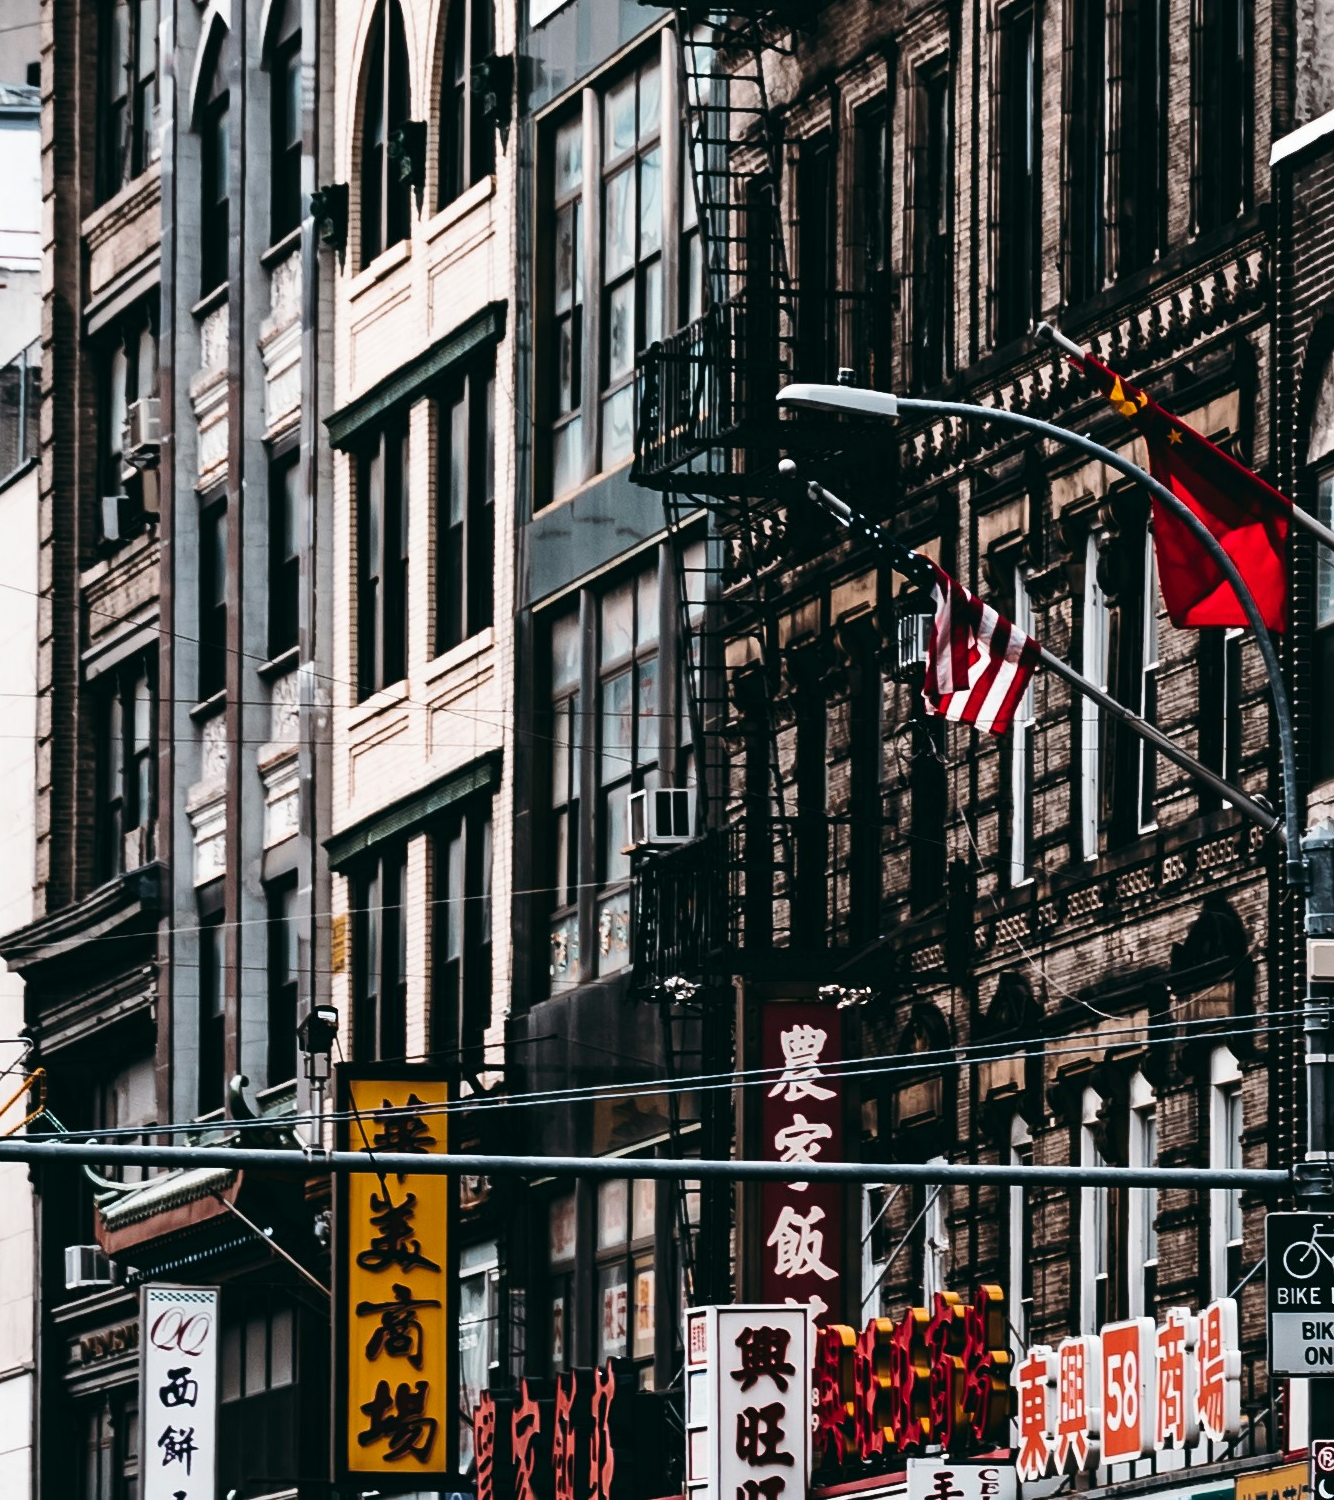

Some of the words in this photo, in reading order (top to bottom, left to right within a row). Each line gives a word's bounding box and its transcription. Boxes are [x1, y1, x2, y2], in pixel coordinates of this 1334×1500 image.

[767, 1024, 839, 1330] 農家飯
[149, 1306, 214, 1358] QQ
[355, 1092, 442, 1465] 華美商場
[1277, 1286, 1322, 1305] BIKE
